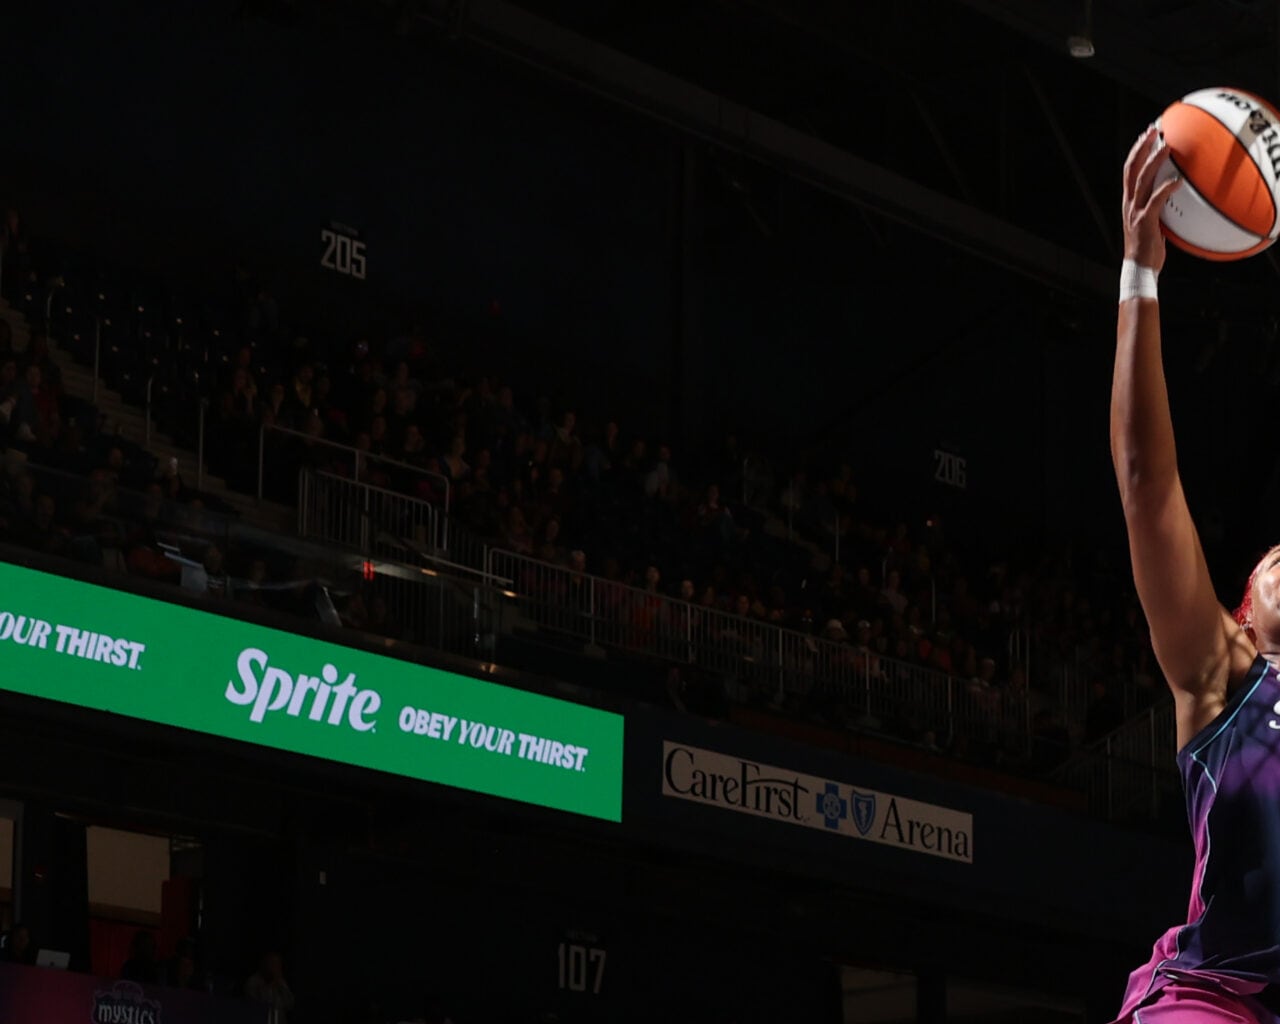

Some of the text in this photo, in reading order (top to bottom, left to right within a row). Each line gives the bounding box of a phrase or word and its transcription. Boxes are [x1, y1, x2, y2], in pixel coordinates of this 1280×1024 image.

[321, 229, 367, 280] 205
[934, 449, 966, 488] 206
[225, 648, 381, 733] Sprite
[399, 706, 458, 741] OBEY
[458, 719, 515, 755] YOUR
[666, 747, 969, 858] CareFirst Arena
[558, 942, 607, 994] 107
